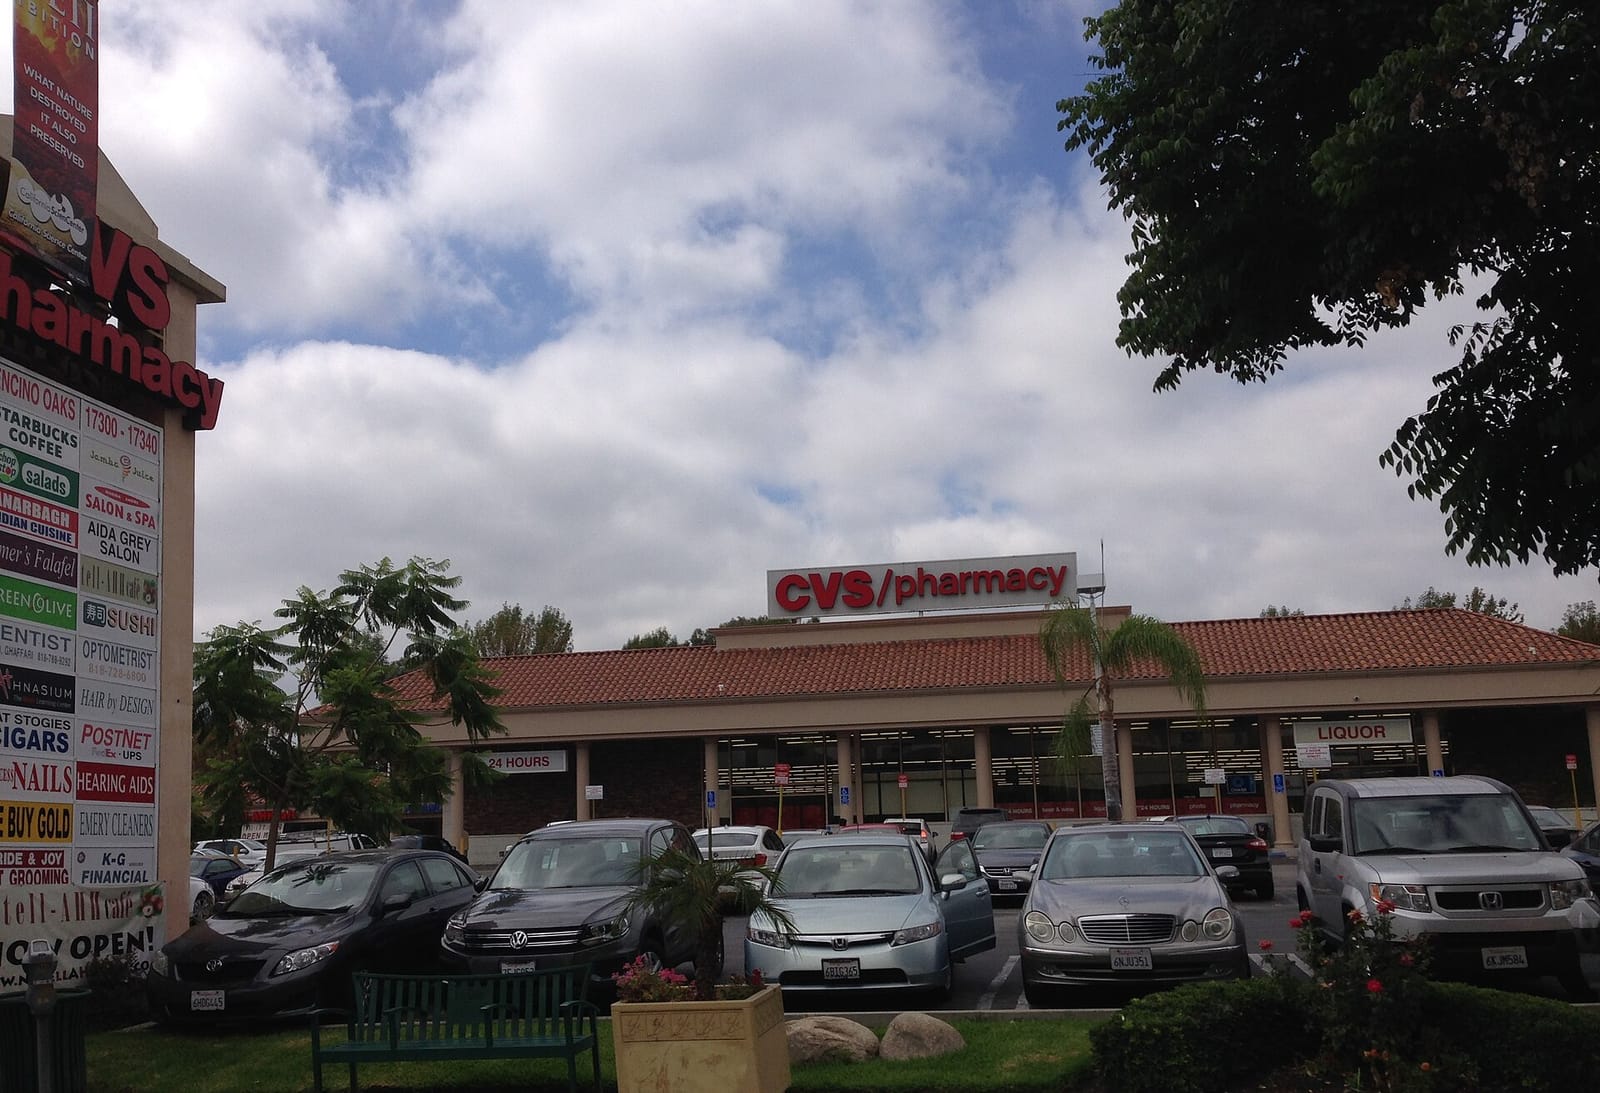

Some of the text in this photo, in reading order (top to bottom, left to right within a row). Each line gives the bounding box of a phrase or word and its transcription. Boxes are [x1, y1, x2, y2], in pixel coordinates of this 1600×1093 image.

[23, 63, 93, 121] WHAT NATURE
[30, 85, 86, 133] DESTROYED
[40, 111, 77, 144] IT ALSO
[30, 123, 85, 169] PRESERVED
[8, 208, 87, 262] California Science Center
[91, 214, 171, 330] VS
[0, 368, 75, 420] NCINO OAKS
[9, 428, 62, 459] COFFEE
[86, 406, 117, 438] 17300
[128, 425, 157, 455] 17340
[26, 470, 66, 495] salads
[0, 491, 70, 528] NARBAGH
[85, 493, 124, 520] SALON
[126, 512, 133, 522] &
[134, 511, 156, 530] SPA
[0, 512, 73, 544] DIAN CUISINE
[88, 521, 151, 553] AIDA GREY
[34, 549, 76, 580] Falafel
[100, 541, 140, 565] SALON
[107, 608, 155, 637] SUSHI
[1, 624, 71, 652] ENTIST
[82, 640, 152, 670] OPTOMETRIST
[80, 689, 153, 716] HAIR by DESIGN
[14, 714, 71, 730] STOGIES
[1318, 726, 1386, 740] LIQUOR
[0, 726, 69, 753] IGARS
[81, 724, 152, 750] POSTNET
[123, 751, 142, 761] UPS
[488, 756, 549, 768] 24 HOURS
[12, 761, 72, 794] NAILS
[77, 772, 153, 795] HEARING AIDS
[8, 806, 34, 838] BUY
[38, 807, 70, 839] GOLD
[80, 812, 153, 837] EMERY CLEANERS
[28, 852, 36, 865] &
[41, 852, 62, 865] JOY
[102, 852, 126, 866] K-G
[10, 869, 69, 885] GROOMING
[81, 870, 149, 884] FINANCIAL
[70, 926, 154, 960] OPEN!
[1113, 956, 1149, 968] 6NJU351
